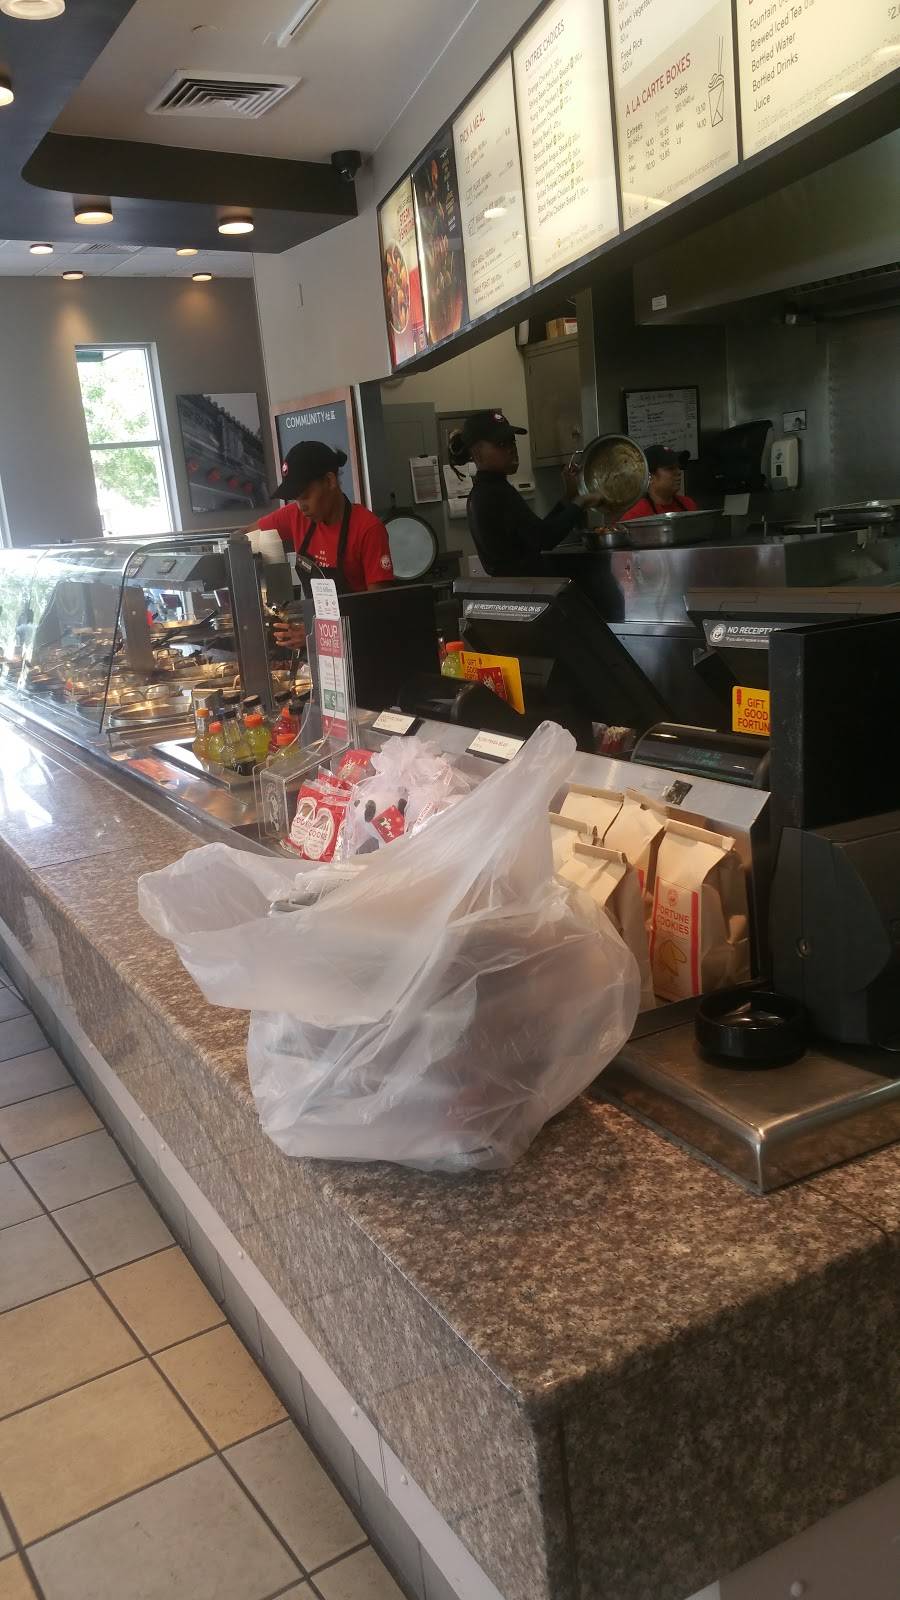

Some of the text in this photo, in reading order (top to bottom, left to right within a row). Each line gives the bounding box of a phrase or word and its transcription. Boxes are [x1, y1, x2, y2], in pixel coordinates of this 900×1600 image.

[750, 3, 776, 31] Fountain
[543, 19, 564, 51] CHOICES
[750, 5, 802, 52] Brewed Iced Tea
[751, 32, 796, 72] Bottled Water
[752, 52, 799, 92] Bottled Drinks
[625, 104, 631, 117] A
[632, 99, 641, 113] LA
[641, 75, 665, 104] CARTE
[666, 53, 691, 85] BOXES
[674, 83, 689, 99] Sides
[753, 93, 771, 112] Juice
[286, 411, 325, 429] COMMUNITY
[318, 623, 338, 639] YOUR
[739, 627, 773, 635] RECEIPT?
[319, 637, 340, 649] CHANGE
[747, 698, 765, 709] GIFT
[744, 708, 768, 720] GOOD
[656, 903, 690, 925] FORTUNE
[656, 915, 689, 935] COOKIES
